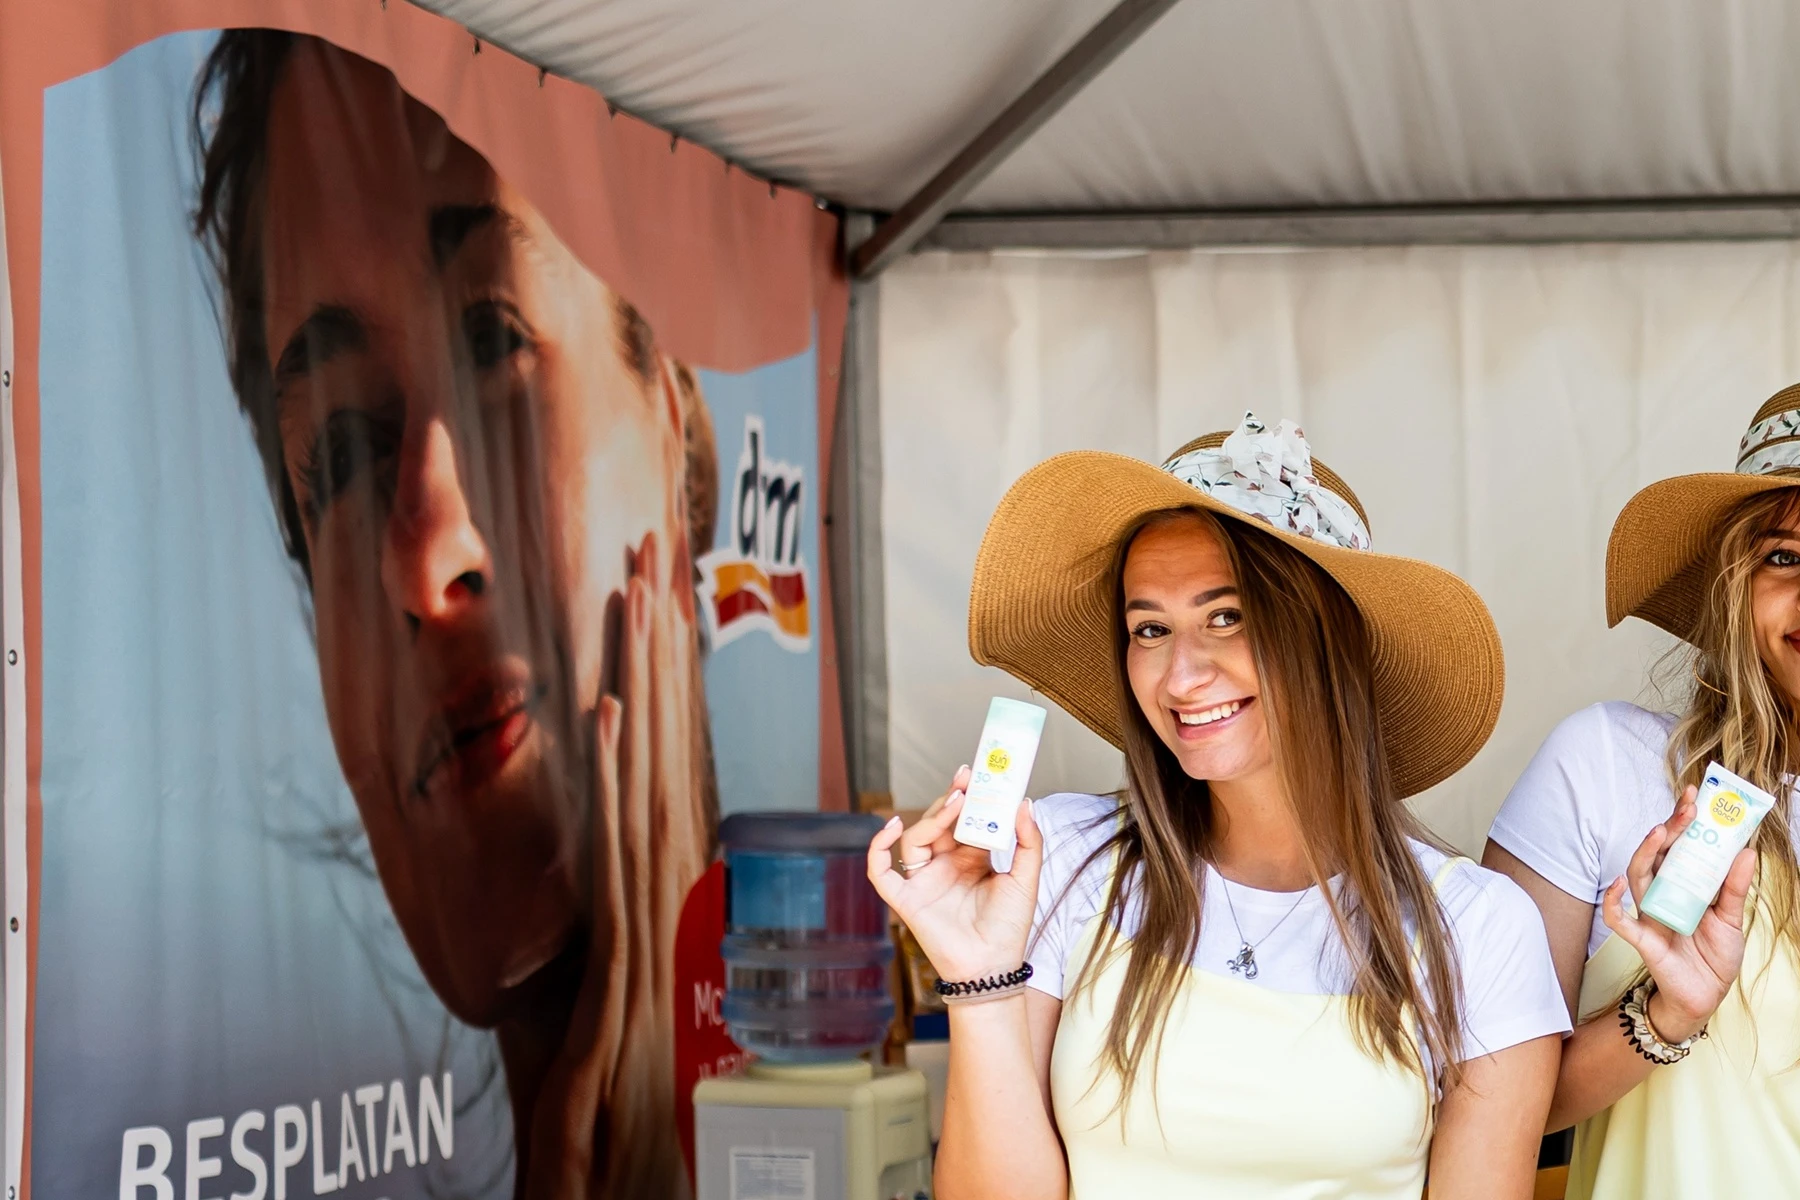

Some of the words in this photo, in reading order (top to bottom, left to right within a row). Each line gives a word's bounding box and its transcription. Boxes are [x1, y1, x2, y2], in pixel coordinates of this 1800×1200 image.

[738, 431, 801, 566] dm
[989, 754, 1008, 766] sun
[974, 771, 991, 784] 30
[1712, 807, 1736, 823] dance
[1716, 797, 1741, 818] sun
